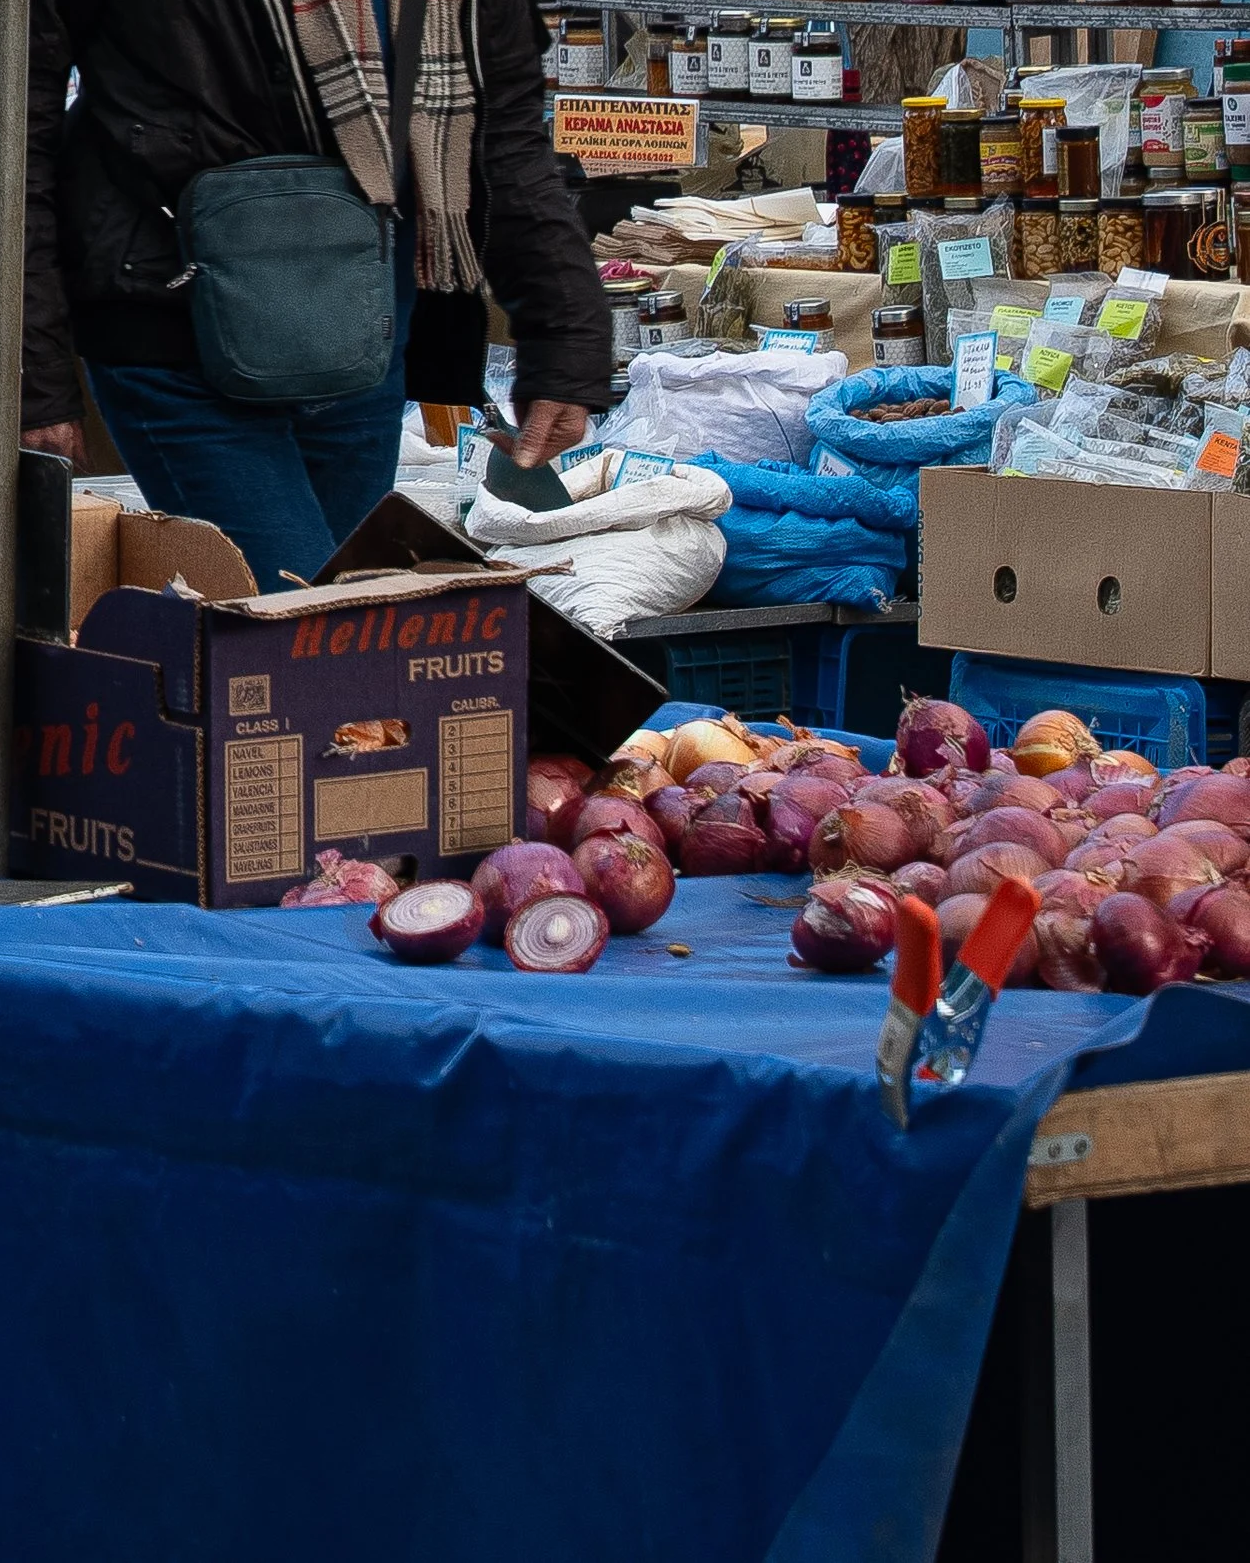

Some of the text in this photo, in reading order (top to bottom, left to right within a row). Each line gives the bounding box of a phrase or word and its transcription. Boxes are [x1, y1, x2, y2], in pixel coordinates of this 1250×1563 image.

[616, 118, 685, 136] ΑΝΑΣΤΑΣΙΑ
[291, 597, 508, 660] Hellenic
[407, 650, 505, 682] FRUITS
[235, 719, 279, 735] CLASS
[232, 746, 265, 760] NAVEL
[232, 764, 274, 780] LEMONS
[30, 807, 136, 863] FRUITS
